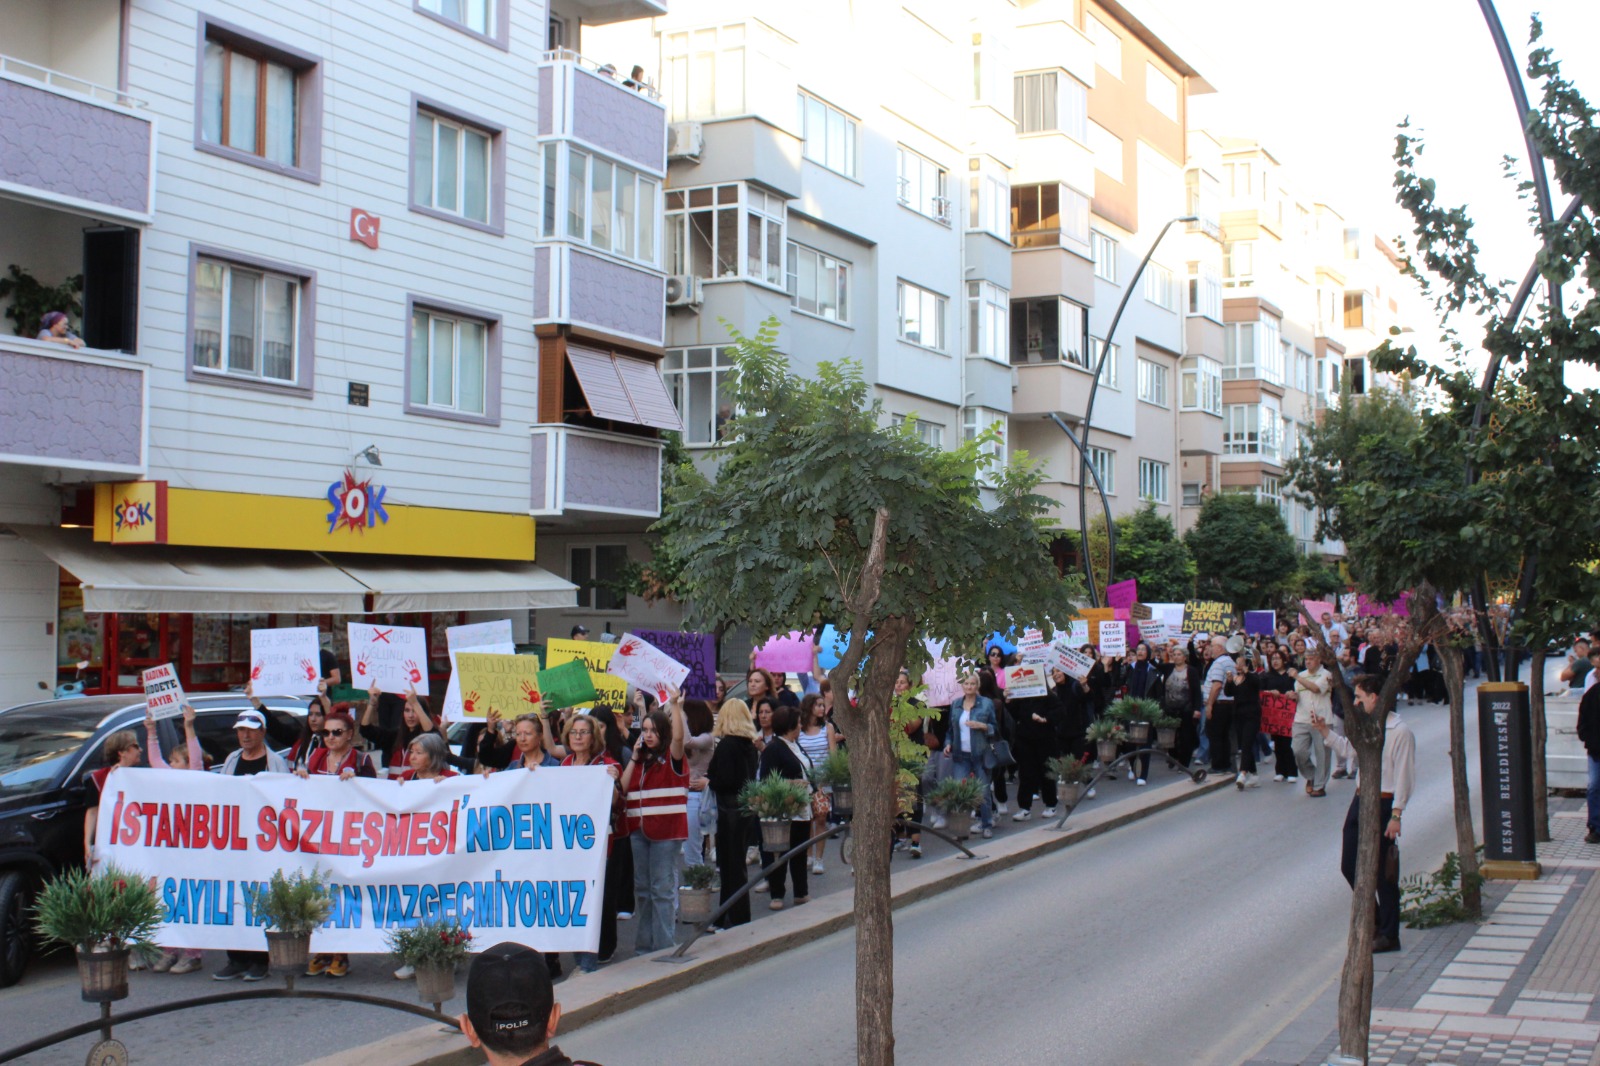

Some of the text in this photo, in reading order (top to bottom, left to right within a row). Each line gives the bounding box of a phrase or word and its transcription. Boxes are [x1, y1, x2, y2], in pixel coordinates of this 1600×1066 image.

[114, 500, 154, 532] ŞOK
[326, 479, 390, 534] ŞOK
[1185, 599, 1232, 614] ÖLDÜREN
[148, 694, 173, 708] HAYIR
[1492, 702, 1511, 710] 2022
[109, 790, 247, 851] İSTANBUL
[559, 813, 596, 850] ve
[162, 876, 235, 926] SAYILI
[240, 879, 363, 929] YAAN
